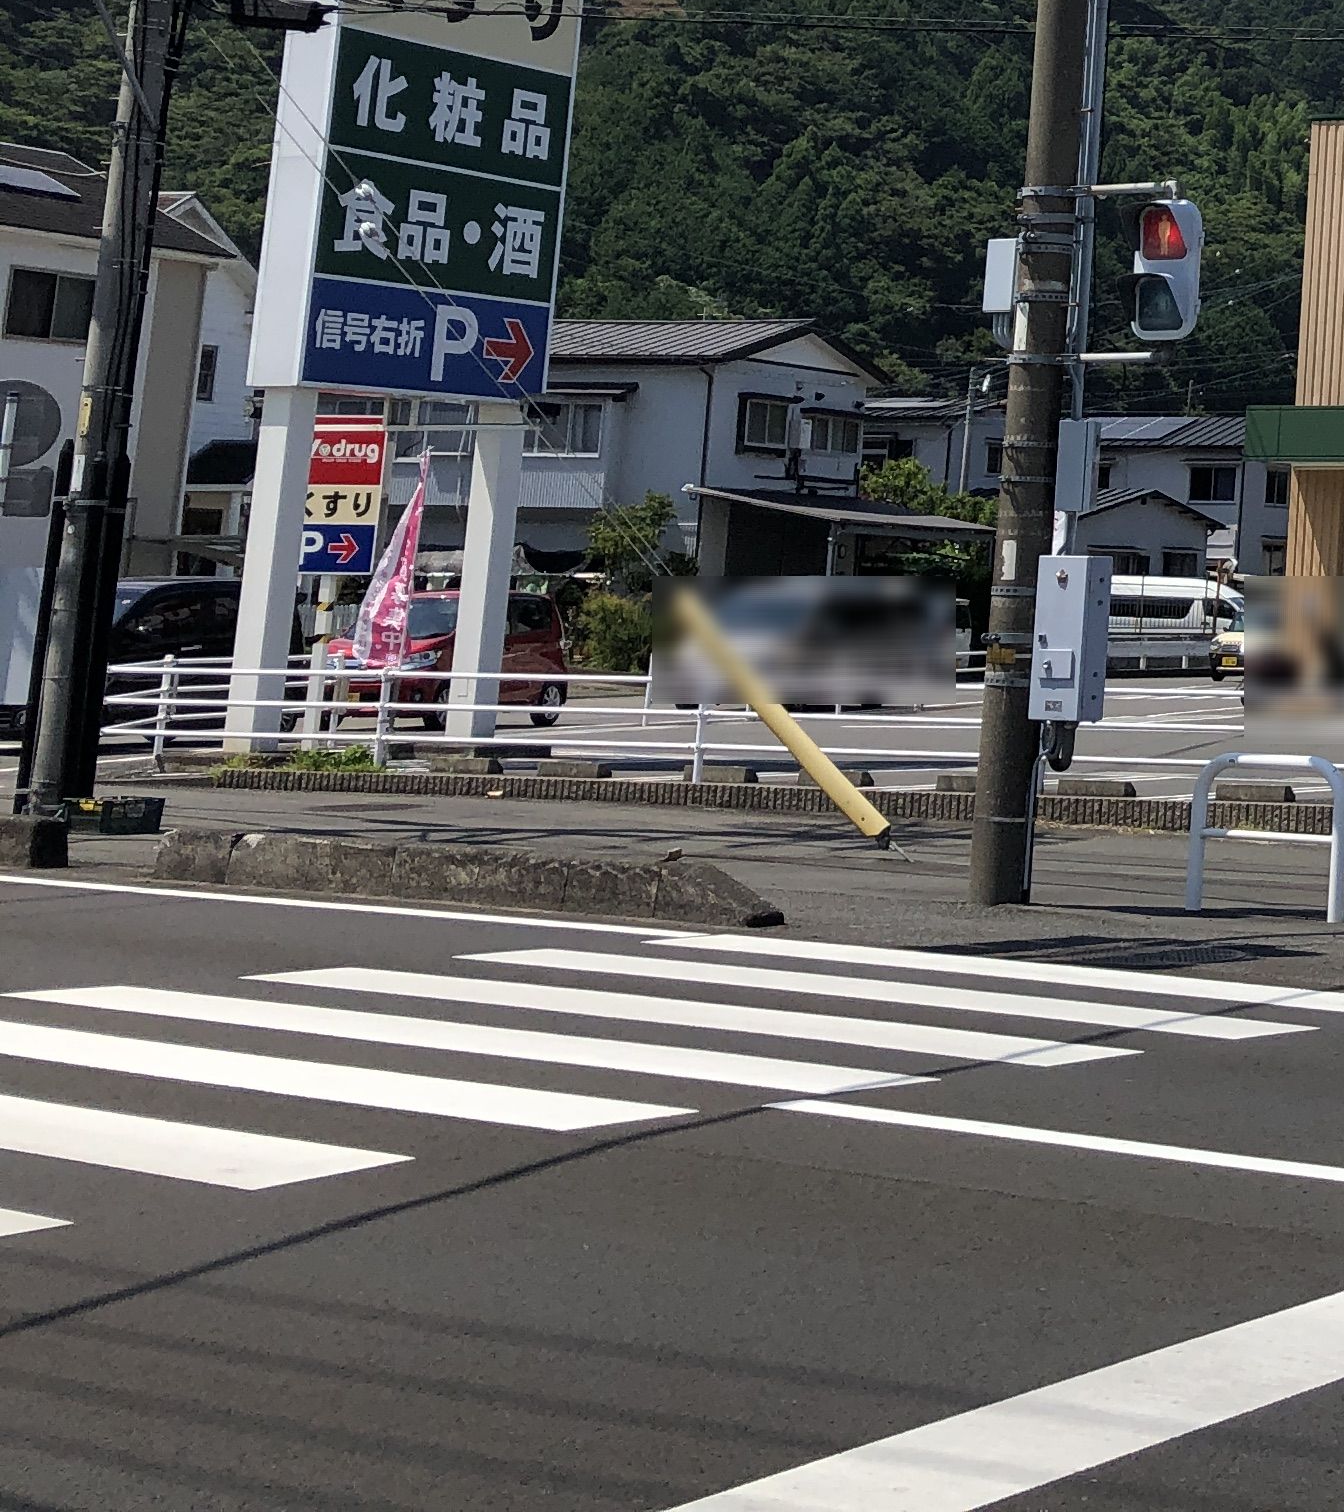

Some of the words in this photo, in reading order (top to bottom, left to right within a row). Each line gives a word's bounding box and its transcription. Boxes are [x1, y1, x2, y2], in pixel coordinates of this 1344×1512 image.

[353, 55, 551, 161] 化粧品
[334, 178, 545, 279] 食品・酒
[315, 308, 425, 358] 信号右折
[430, 304, 478, 381] P
